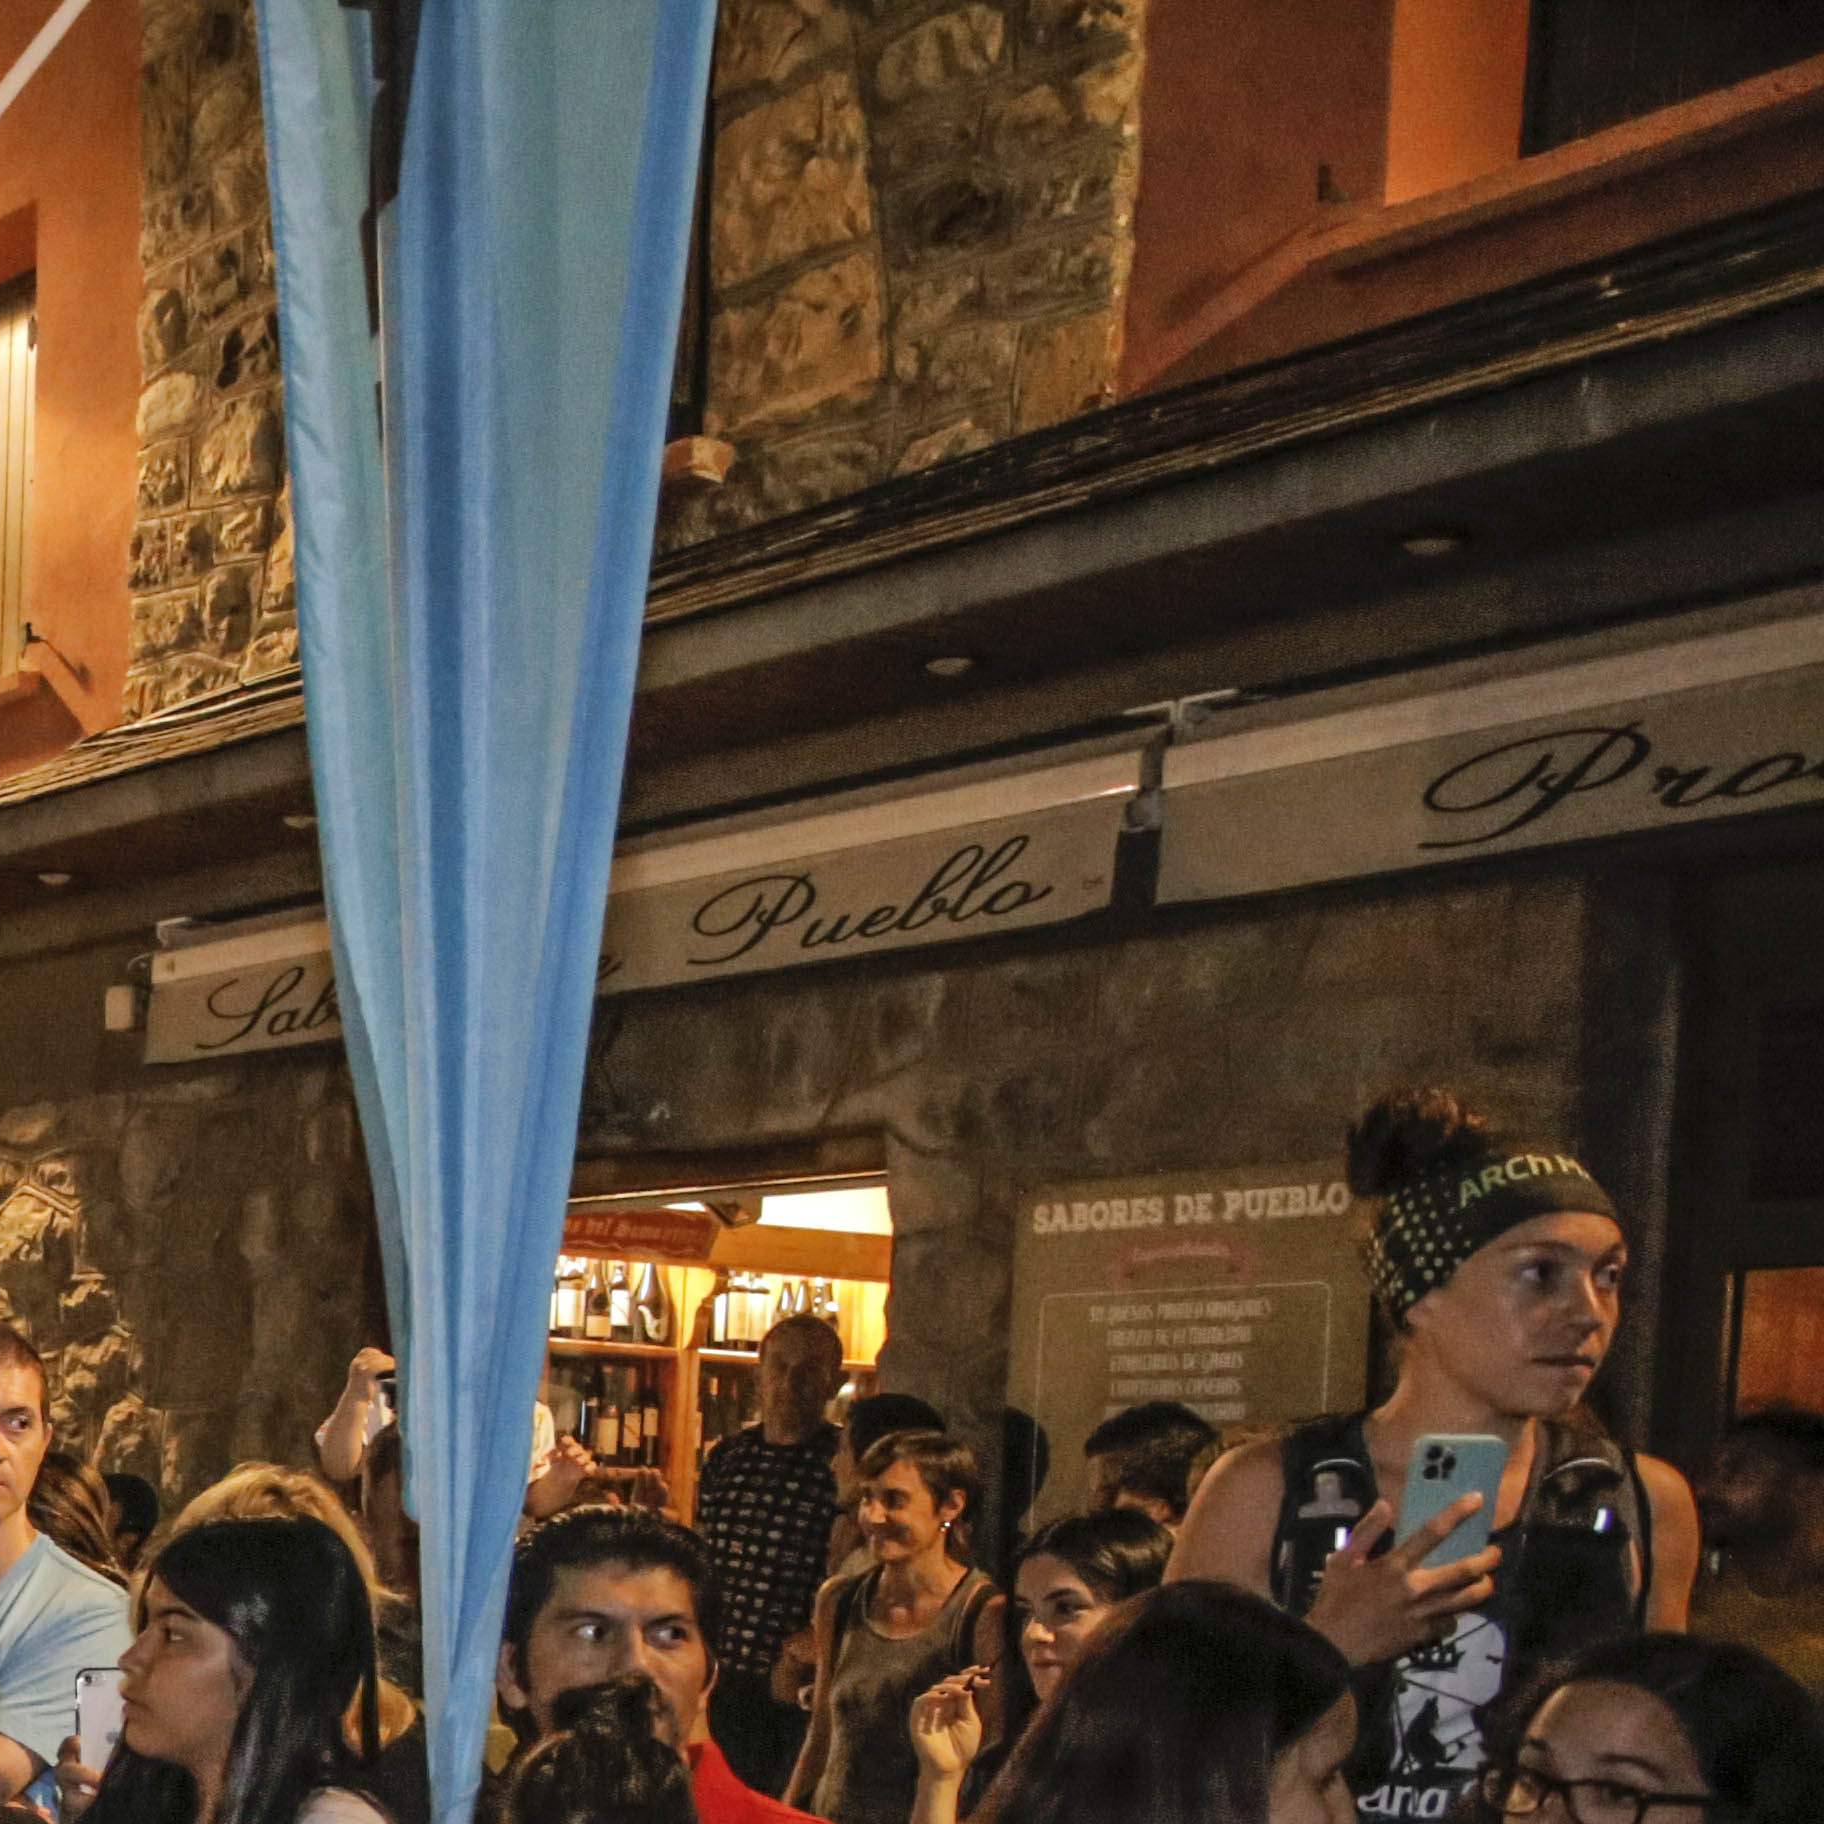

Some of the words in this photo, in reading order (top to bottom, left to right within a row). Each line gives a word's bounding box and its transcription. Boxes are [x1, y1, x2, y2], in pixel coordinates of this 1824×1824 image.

[1417, 720, 1824, 849] Pro
[196, 965, 338, 1050] Sab
[686, 835, 1052, 966] Pueblo
[1033, 1200, 1164, 1233] SABORES
[1174, 1193, 1213, 1225] DE
[1222, 1182, 1350, 1223] PUEBLO
